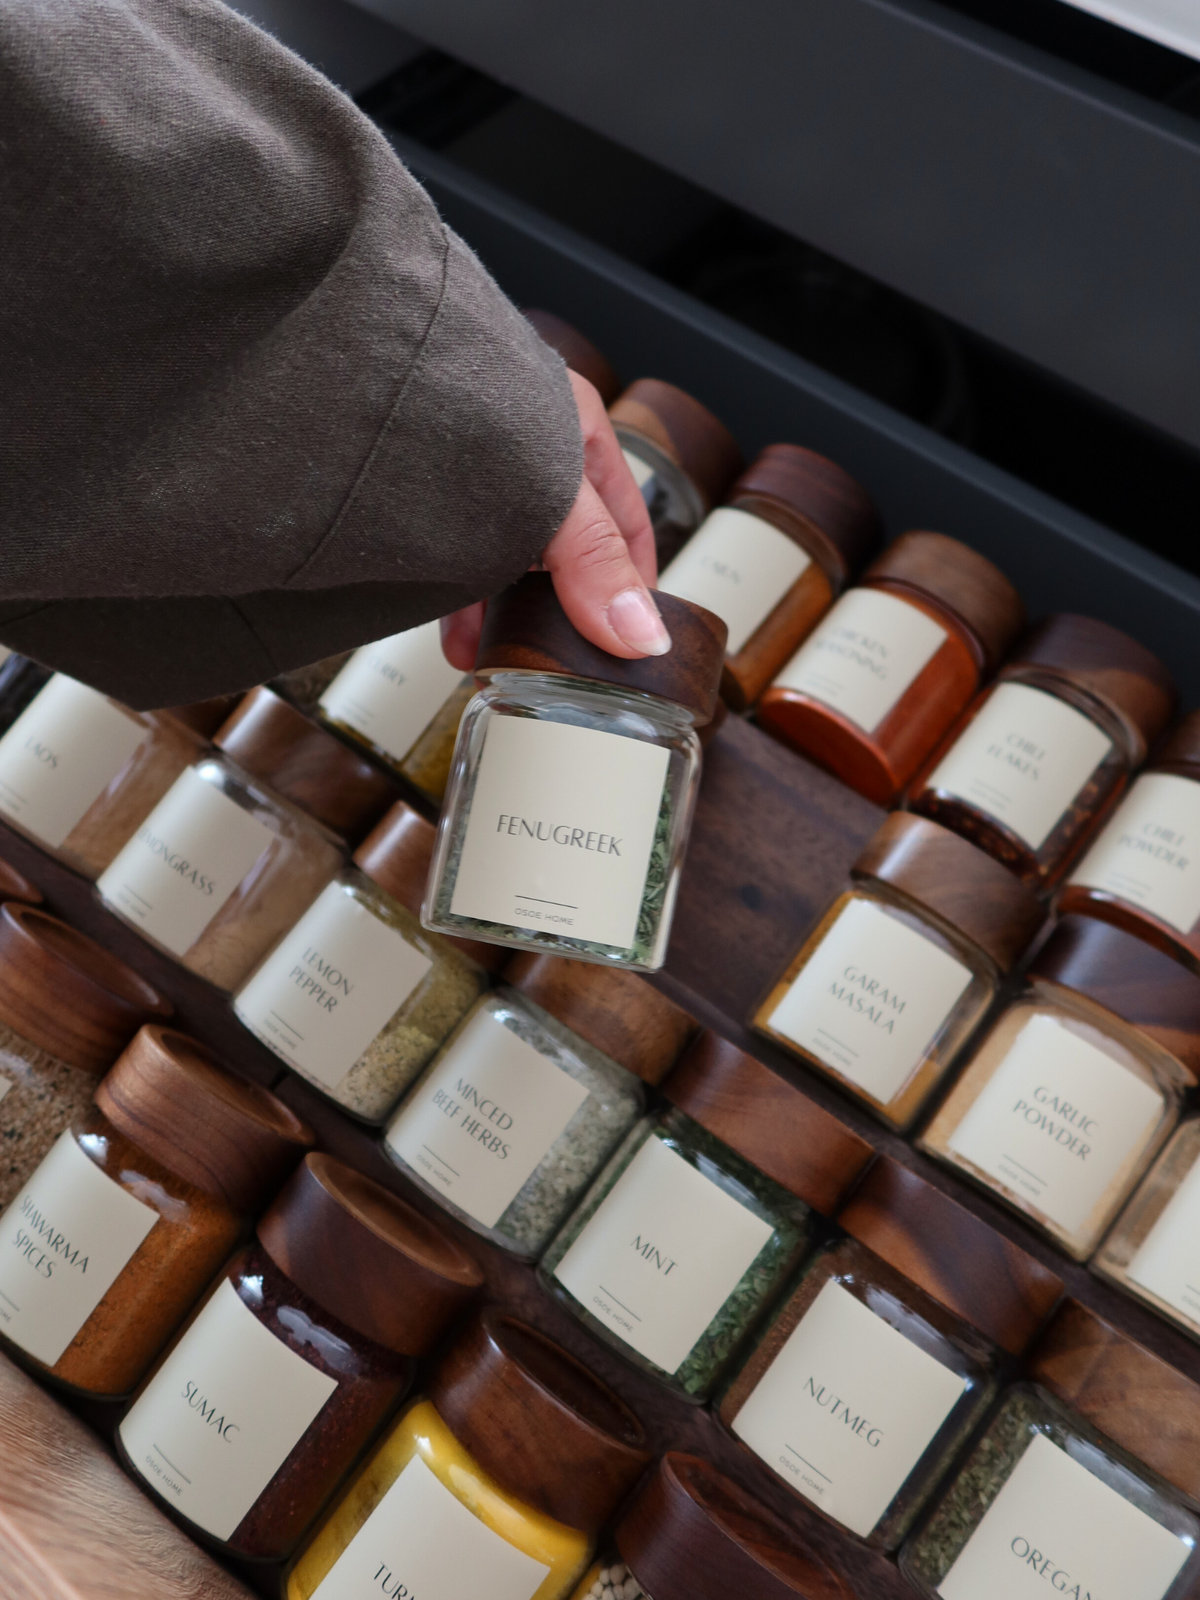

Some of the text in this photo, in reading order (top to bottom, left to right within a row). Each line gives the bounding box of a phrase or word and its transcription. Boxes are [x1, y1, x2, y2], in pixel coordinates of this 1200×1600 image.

[496, 814, 623, 857] FENUGREEK
[139, 827, 216, 896] EMONGRASS
[544, 913, 574, 926] HOME
[289, 966, 338, 1013] PEPPER
[301, 947, 355, 996] LEMON
[844, 966, 907, 1015] GARAM
[826, 981, 895, 1035] MASALA
[432, 1088, 511, 1160] BEEF HERBS
[454, 1077, 513, 1131] MINCED
[1034, 1086, 1099, 1137] GARLIC
[1012, 1099, 1091, 1162] POWDER
[12, 1229, 56, 1278] SPICES
[20, 1194, 90, 1274] SHAWARMA
[629, 1234, 678, 1276] MINT
[612, 1312, 634, 1333] HOME
[181, 1380, 240, 1443] SUMAC
[802, 1376, 884, 1447] NUTMEG
[162, 1474, 183, 1496] HOME
[801, 1474, 825, 1494] HOME
[373, 1561, 415, 1600] TUR
